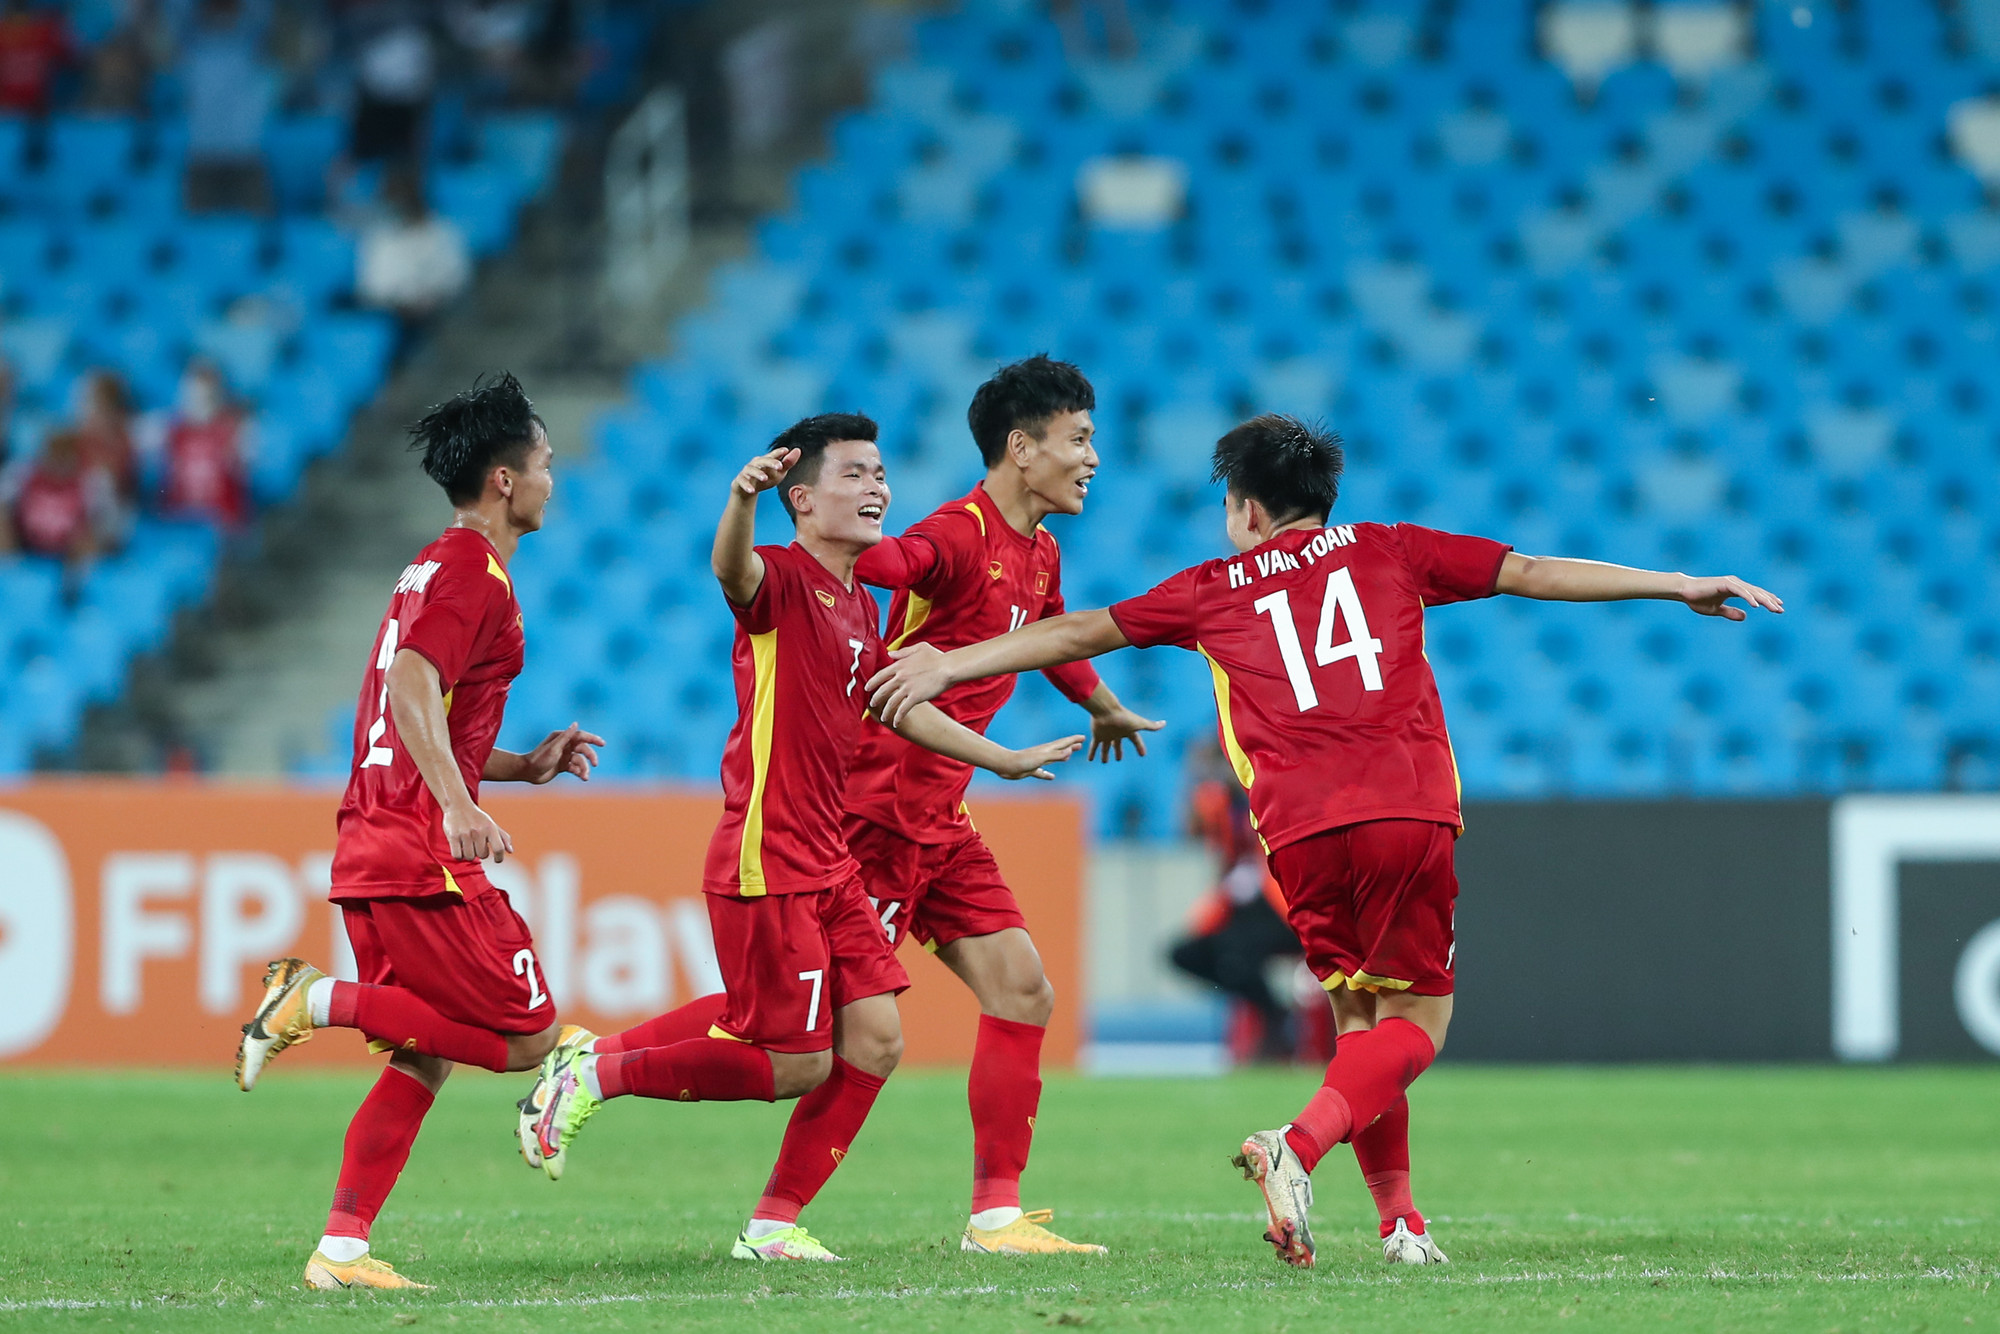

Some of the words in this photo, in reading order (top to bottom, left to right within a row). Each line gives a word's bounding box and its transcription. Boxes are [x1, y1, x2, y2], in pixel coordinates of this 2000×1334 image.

[1228, 562, 1253, 589] H.
[1254, 549, 1301, 578] VAN
[1300, 524, 1357, 566] TOAN
[848, 638, 864, 697] 7
[1254, 566, 1384, 713] 14
[868, 896, 901, 944] 6
[512, 948, 547, 1011] 2
[798, 969, 823, 1032] 7
